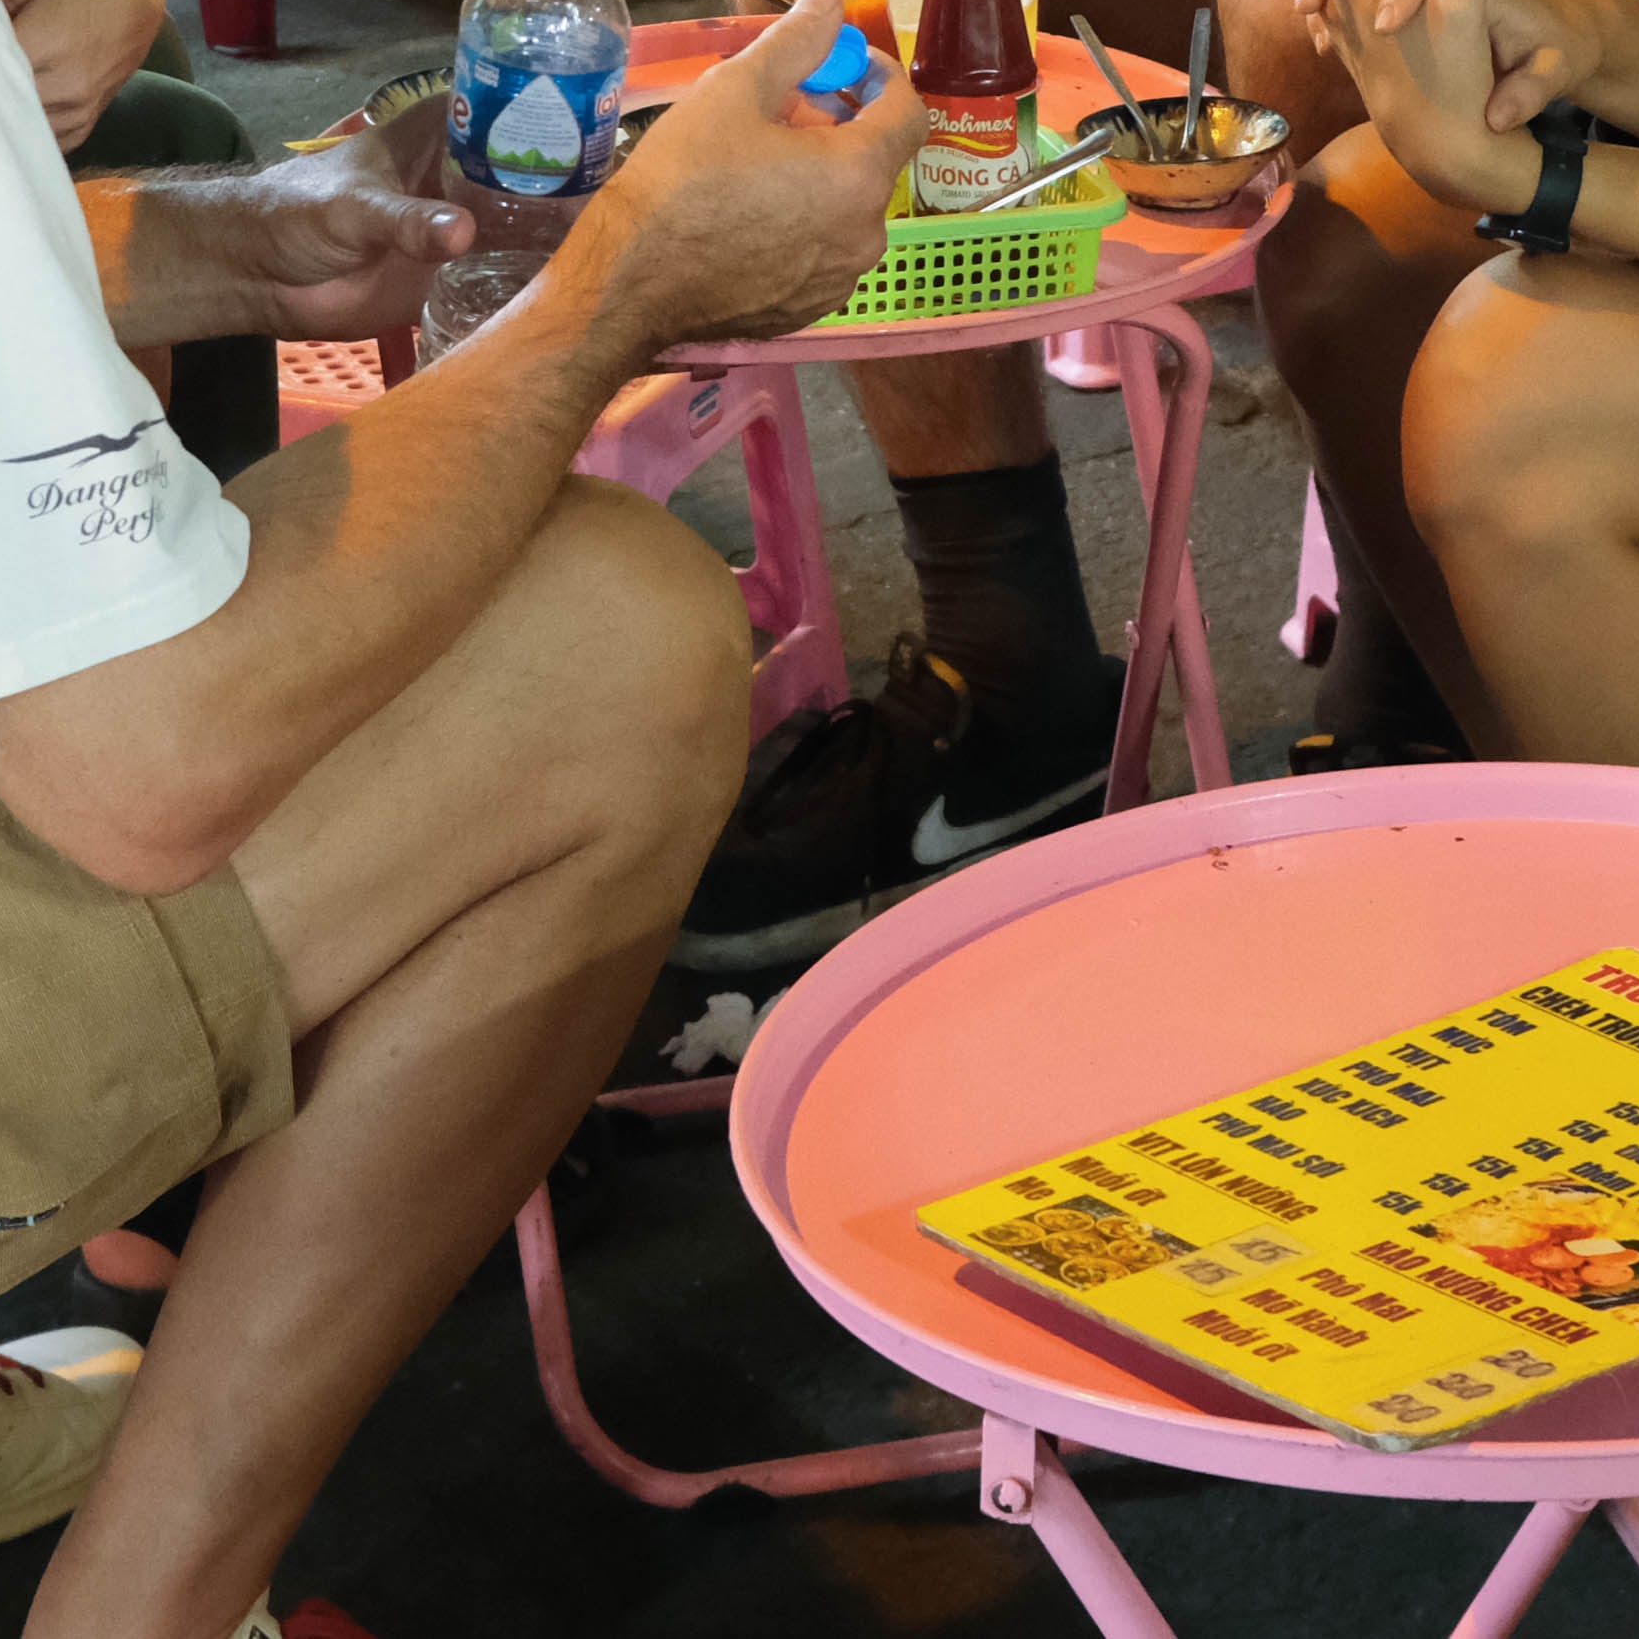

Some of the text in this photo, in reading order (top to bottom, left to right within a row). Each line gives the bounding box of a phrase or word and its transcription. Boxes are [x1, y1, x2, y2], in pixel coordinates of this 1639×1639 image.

[928, 108, 1014, 133] Cholimex
[1519, 985, 1598, 1020] CHÉN
[1477, 1008, 1537, 1036] TÔM
[1388, 1043, 1450, 1071] THỊT
[1386, 1082, 1446, 1107] MAI
[1246, 1134, 1305, 1159] MAI
[1003, 1175, 1055, 1201] Me
[1359, 1240, 1431, 1272] HÀO
[1510, 1306, 1600, 1345] CHÉN
[1350, 1291, 1423, 1323] Mai
